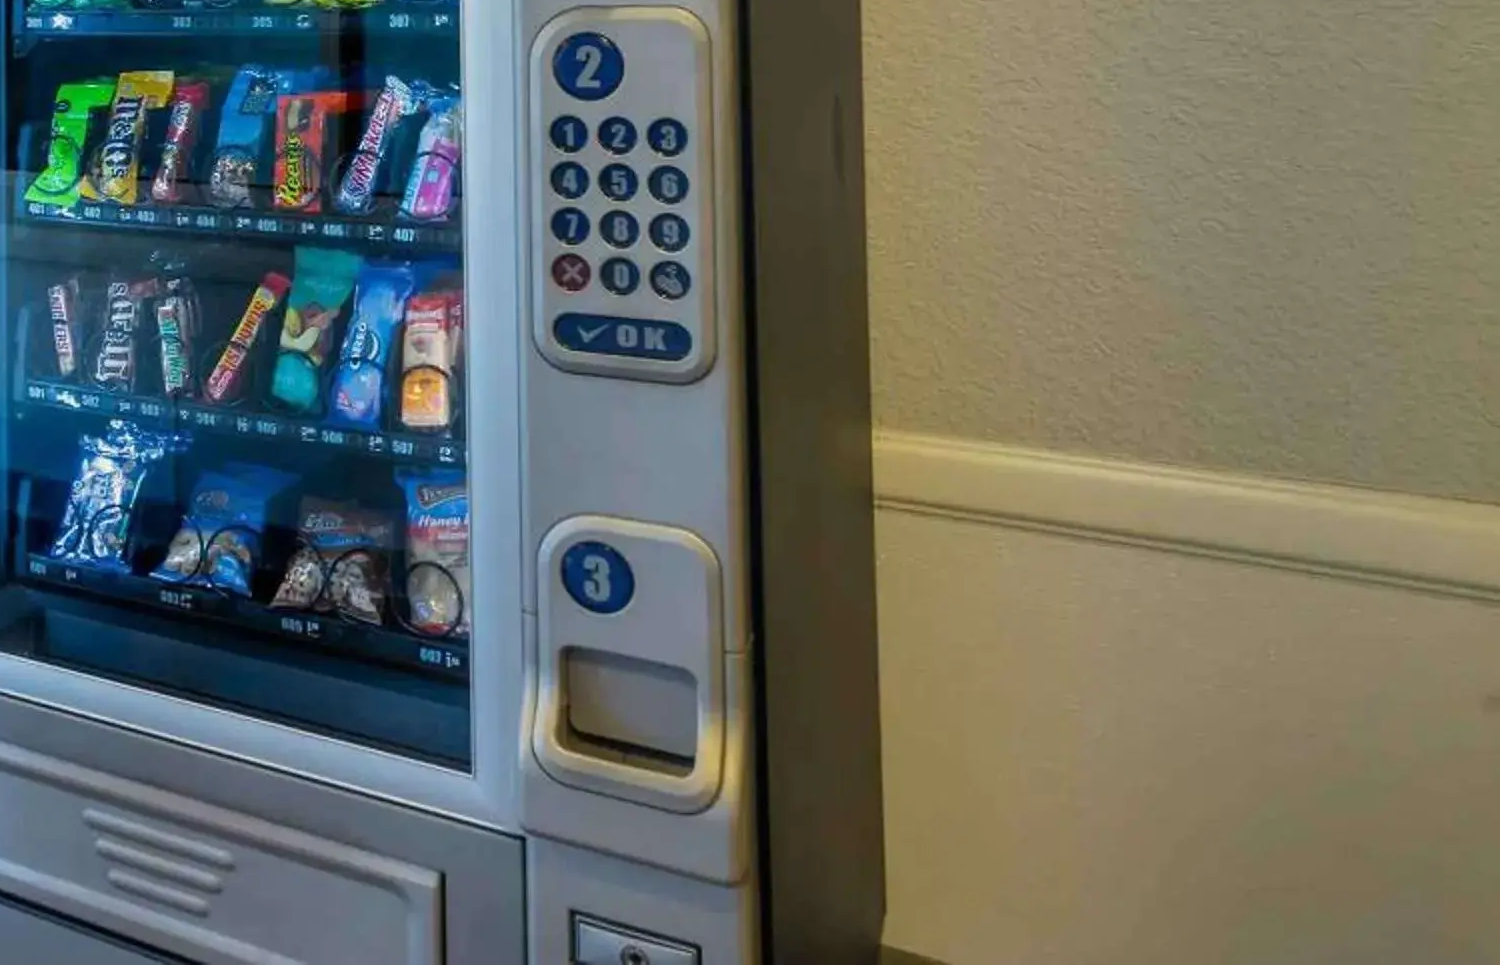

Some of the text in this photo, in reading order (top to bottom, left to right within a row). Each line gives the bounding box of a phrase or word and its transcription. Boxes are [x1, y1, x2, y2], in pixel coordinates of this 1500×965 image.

[575, 45, 602, 88] 2
[563, 123, 575, 146] 1
[611, 124, 626, 147] 2
[660, 125, 676, 150] 3
[562, 169, 577, 193] 4
[611, 171, 627, 195] 5
[661, 173, 678, 198] 6
[565, 214, 579, 238] 7
[613, 216, 628, 241] 8
[662, 219, 679, 245] 9
[614, 263, 629, 289] 0
[616, 324, 666, 350] OK
[583, 554, 611, 603] 3
